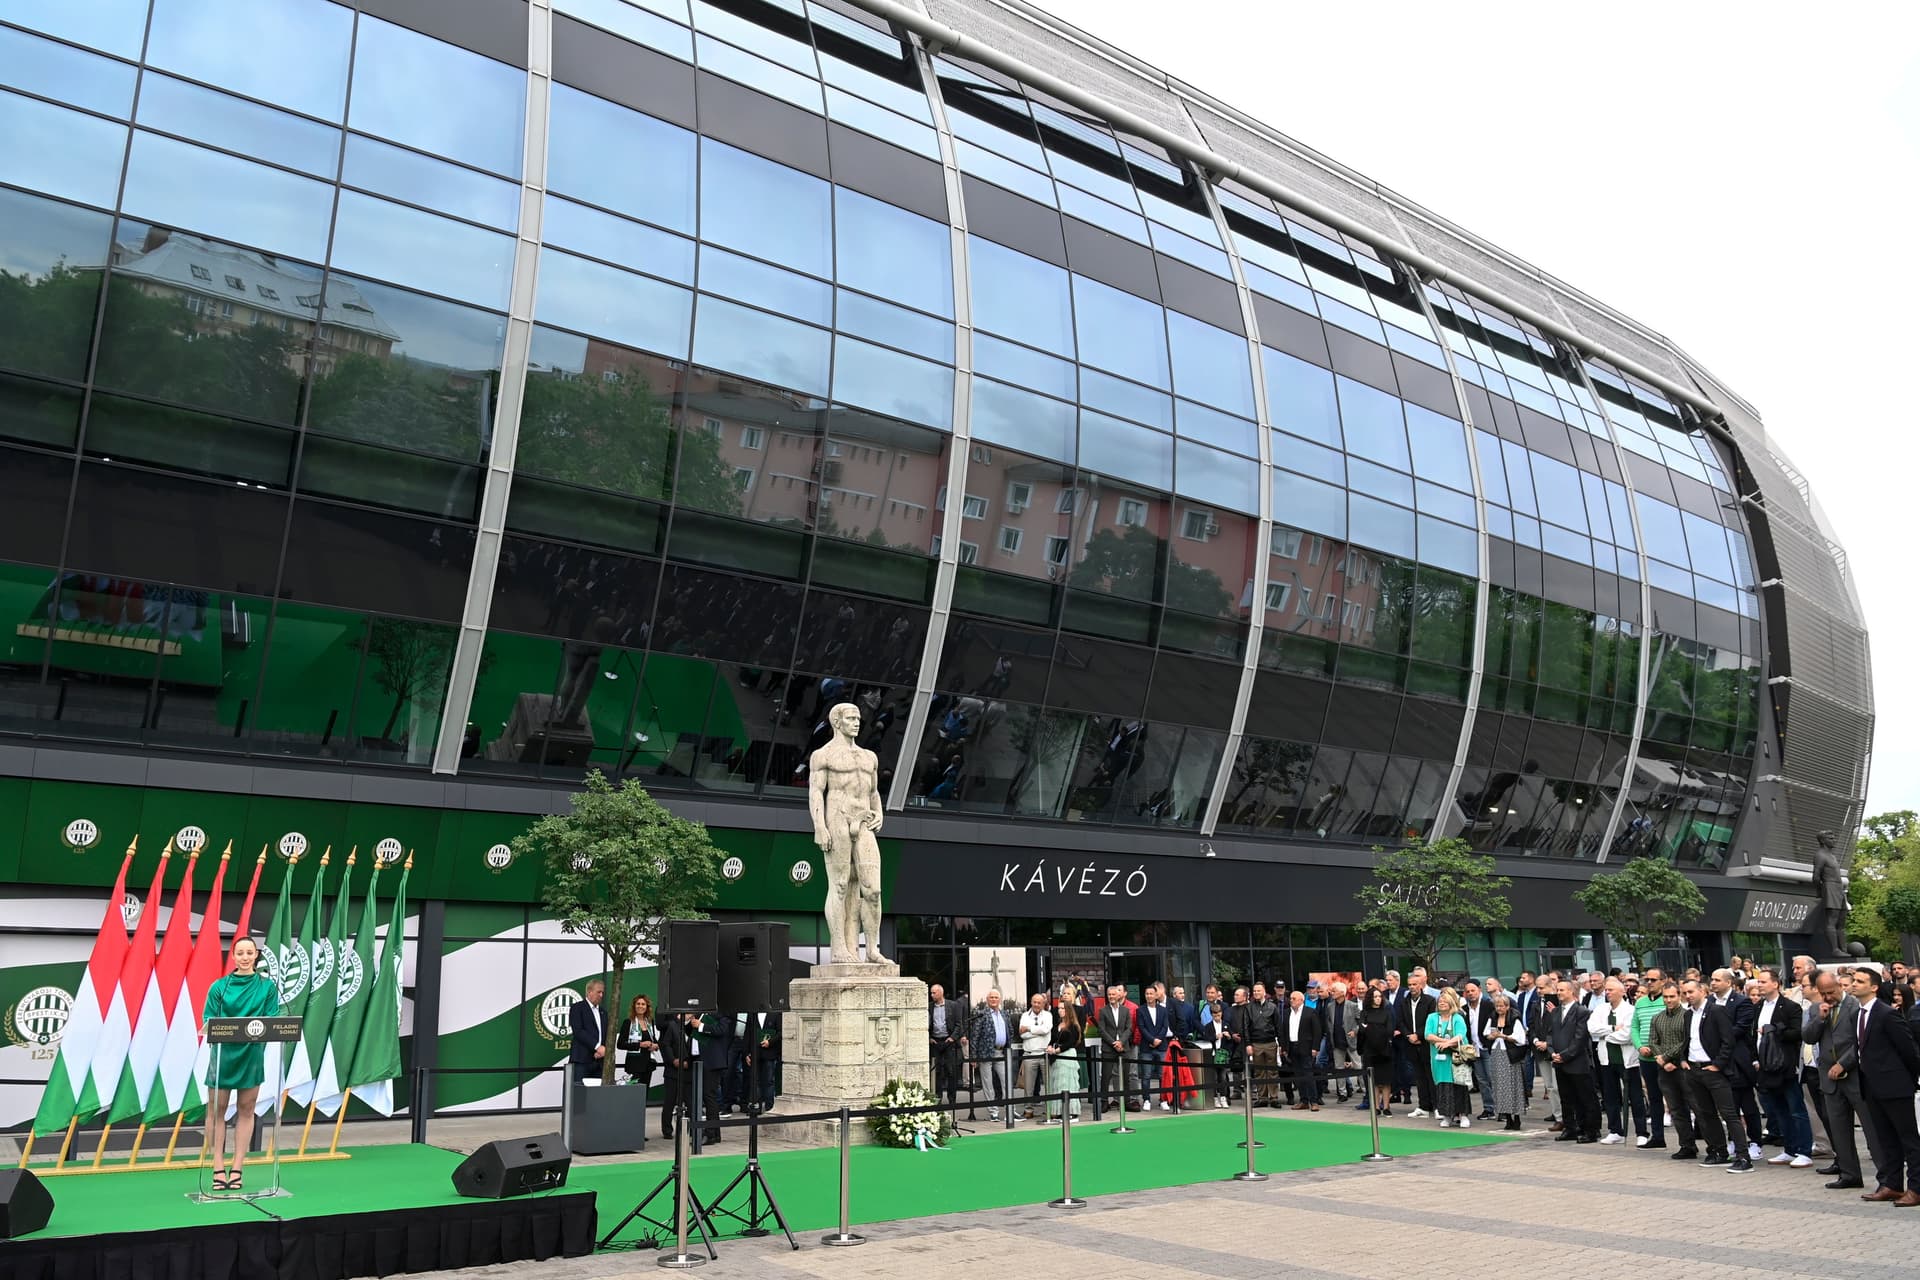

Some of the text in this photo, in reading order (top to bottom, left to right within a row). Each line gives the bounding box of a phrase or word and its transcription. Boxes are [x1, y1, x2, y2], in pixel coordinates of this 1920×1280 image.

[1000, 859, 1148, 897] KÁVÉZÓ
[1752, 900, 1808, 921] BRONZ JOBB
[291, 968, 309, 995] TORNA
[344, 972, 362, 999] TORNA
[31, 1048, 54, 1060] 125
